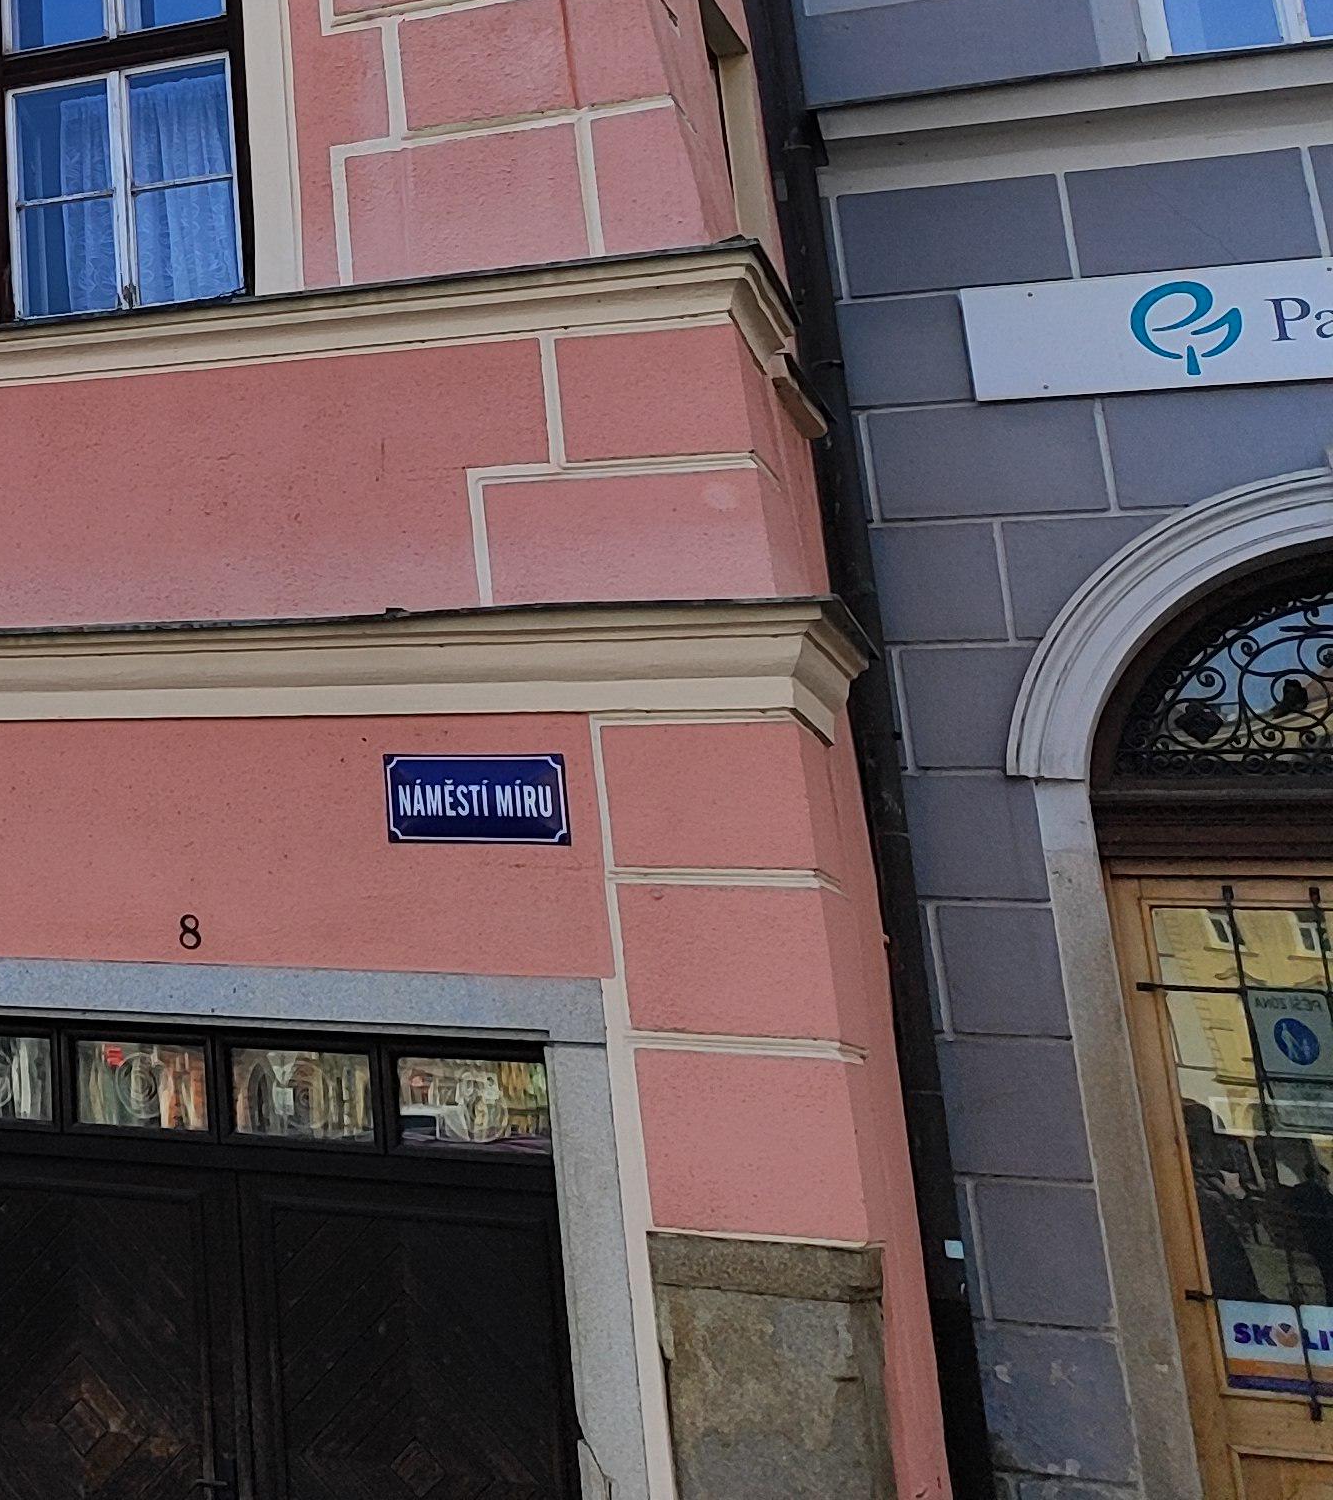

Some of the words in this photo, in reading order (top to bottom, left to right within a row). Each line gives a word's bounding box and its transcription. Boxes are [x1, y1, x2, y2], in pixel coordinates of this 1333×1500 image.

[397, 778, 490, 817] NÁMĚSTÍ
[494, 778, 553, 818] MÍRU
[178, 913, 202, 950] 8
